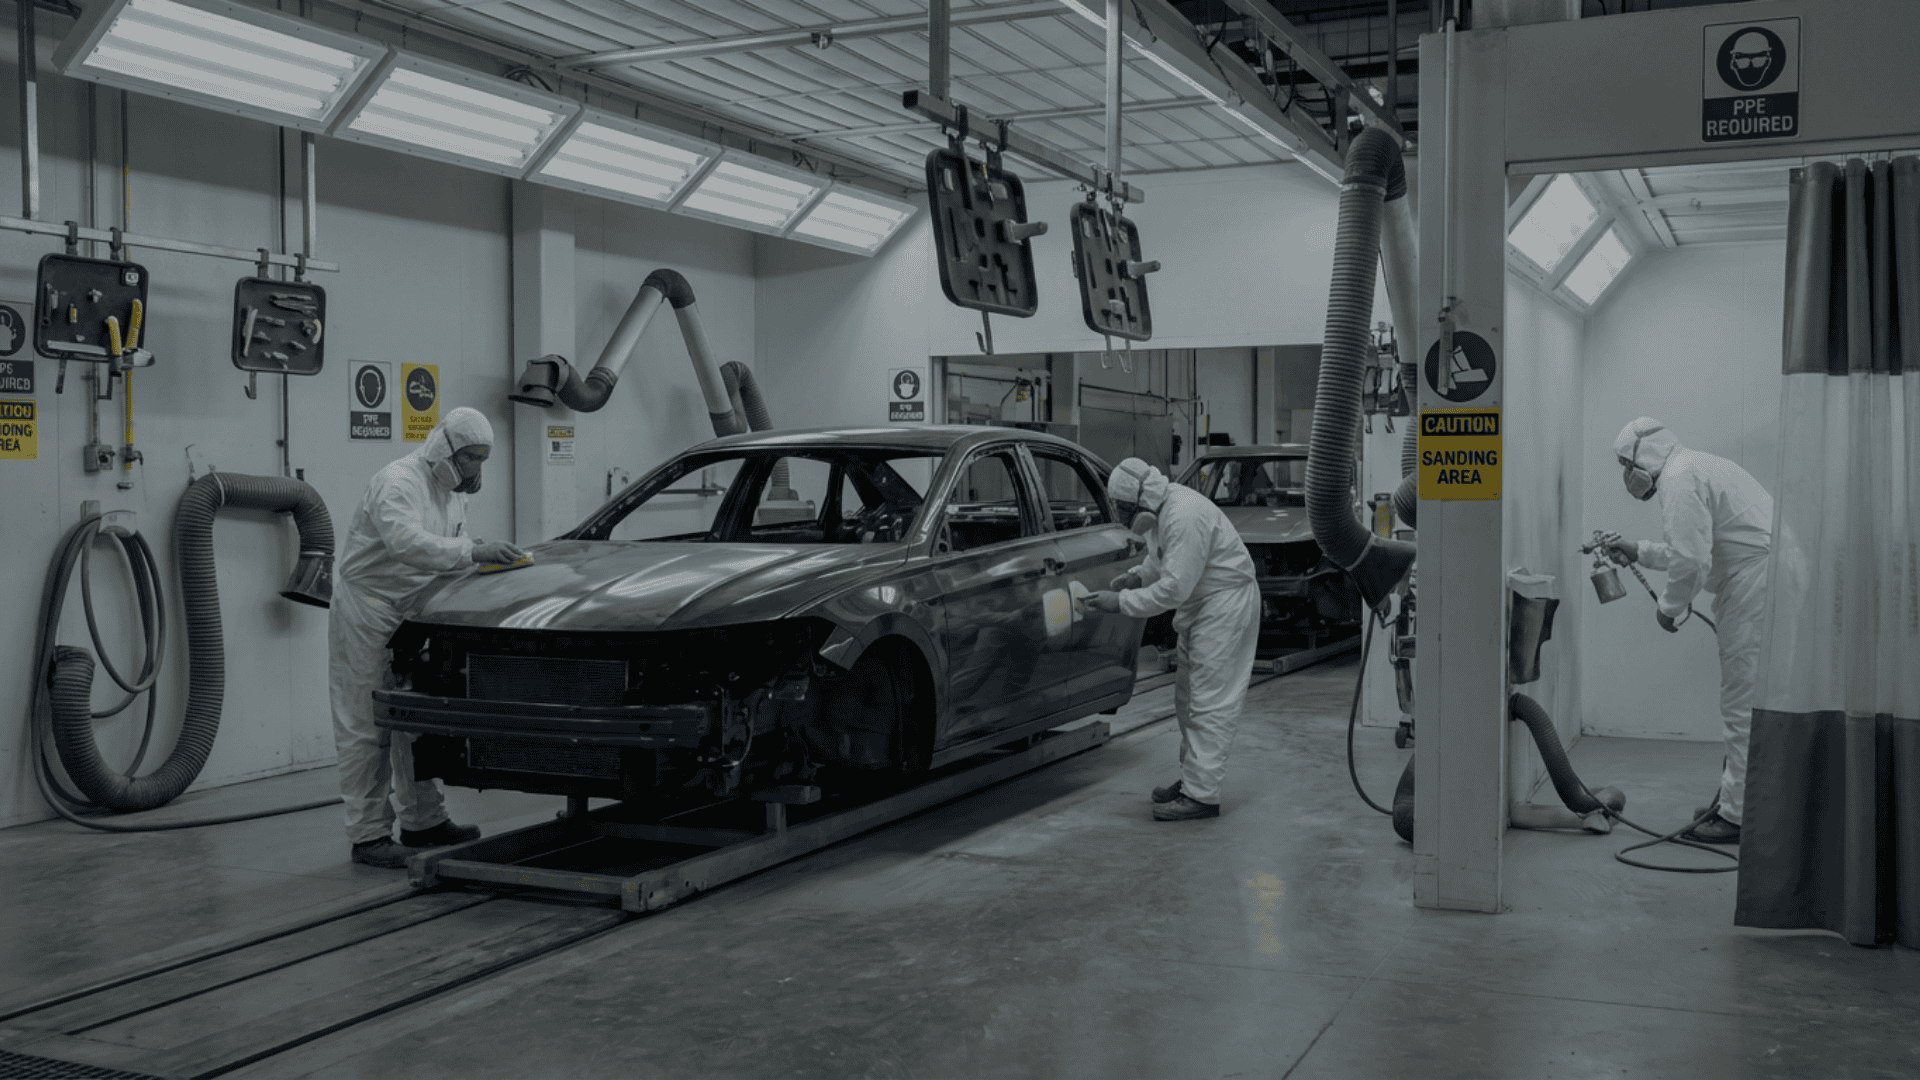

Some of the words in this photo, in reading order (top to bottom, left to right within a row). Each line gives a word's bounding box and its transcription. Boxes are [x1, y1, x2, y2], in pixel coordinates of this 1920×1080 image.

[1733, 98, 1767, 116] PPE
[1425, 416, 1496, 433] CAUTION
[1422, 450, 1498, 467] SANDING
[1437, 468, 1483, 485] AREA
